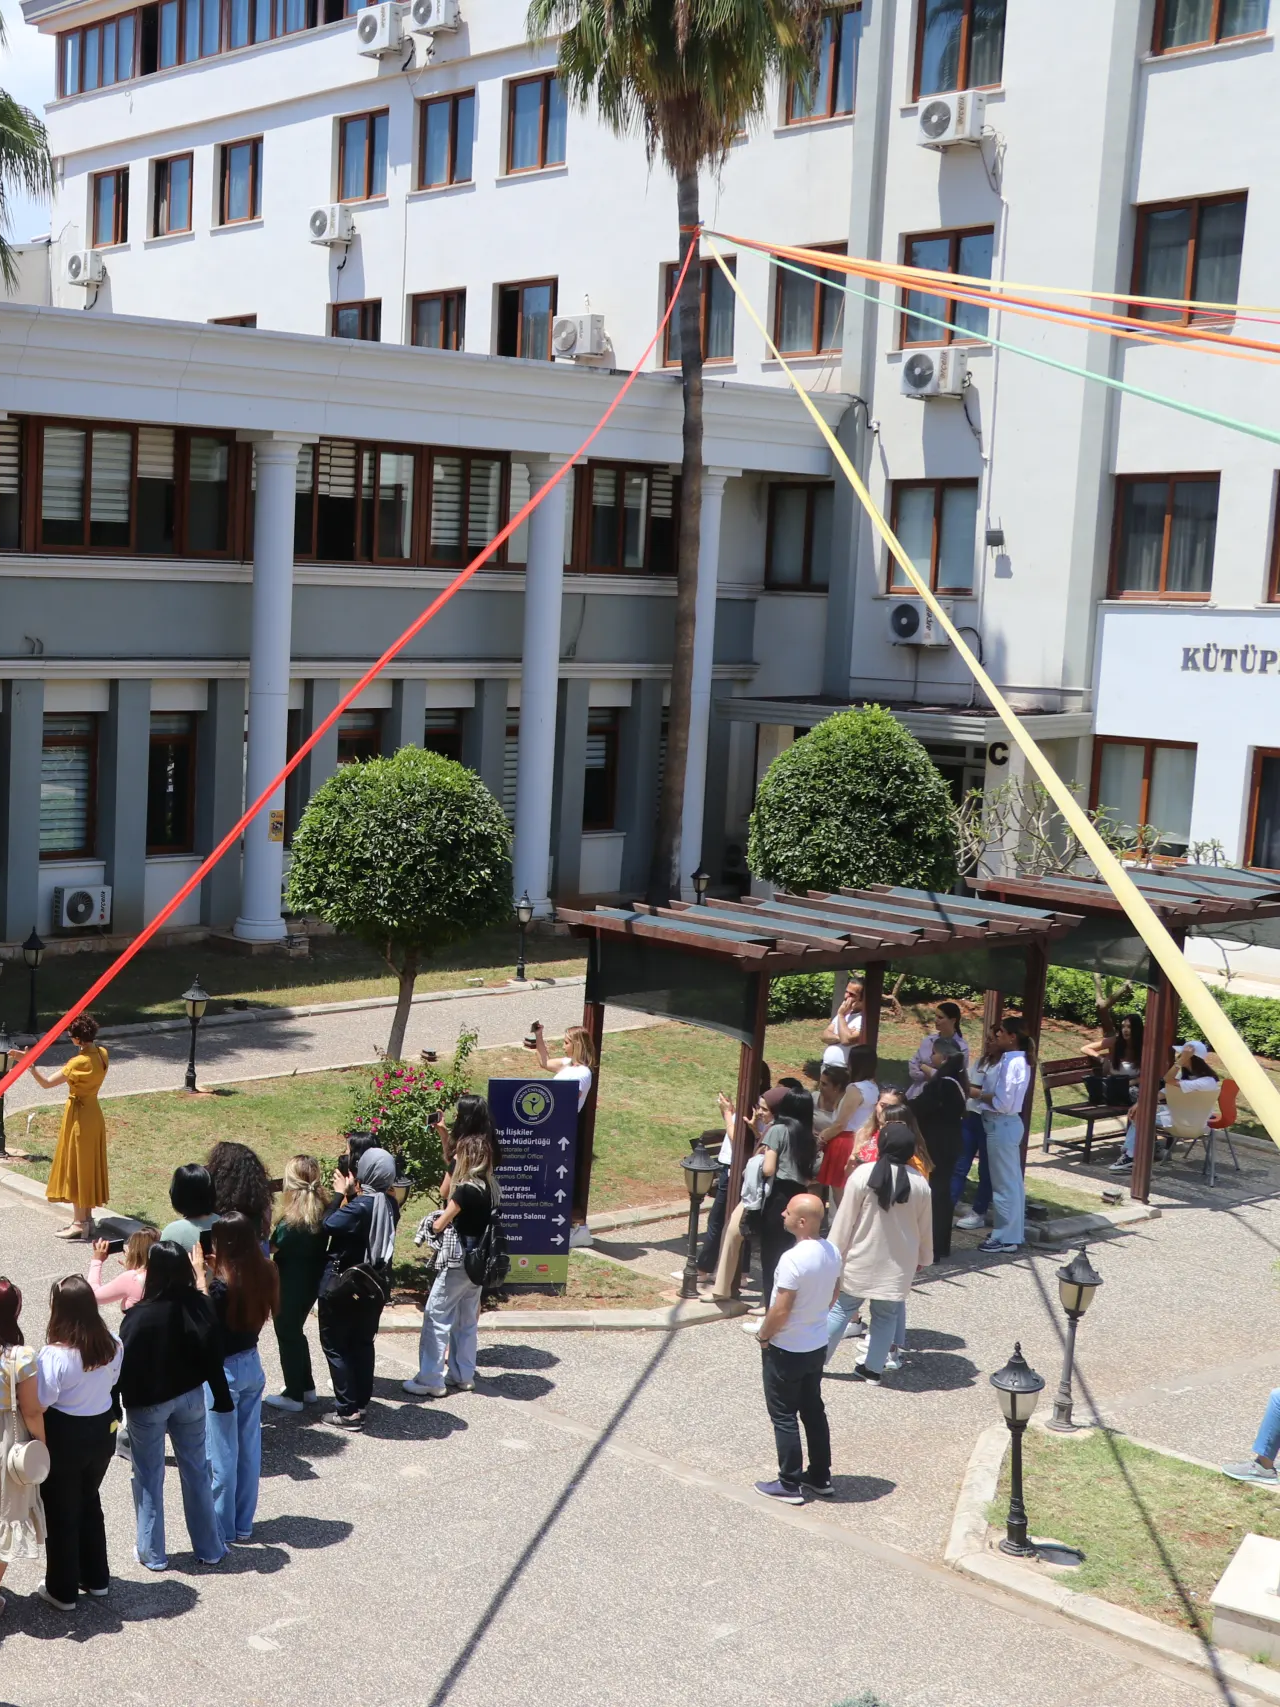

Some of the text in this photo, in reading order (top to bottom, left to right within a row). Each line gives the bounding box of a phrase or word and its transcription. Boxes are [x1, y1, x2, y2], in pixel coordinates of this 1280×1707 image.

[1180, 642, 1280, 674] KÜTÜP
[988, 742, 1009, 766] C
[506, 1127, 534, 1137] İlişkiler
[497, 1137, 551, 1147] ube Müdürlüğü
[523, 1164, 540, 1172] Ofisi
[515, 1192, 537, 1200] Birimi
[523, 1212, 547, 1220] Salonu
